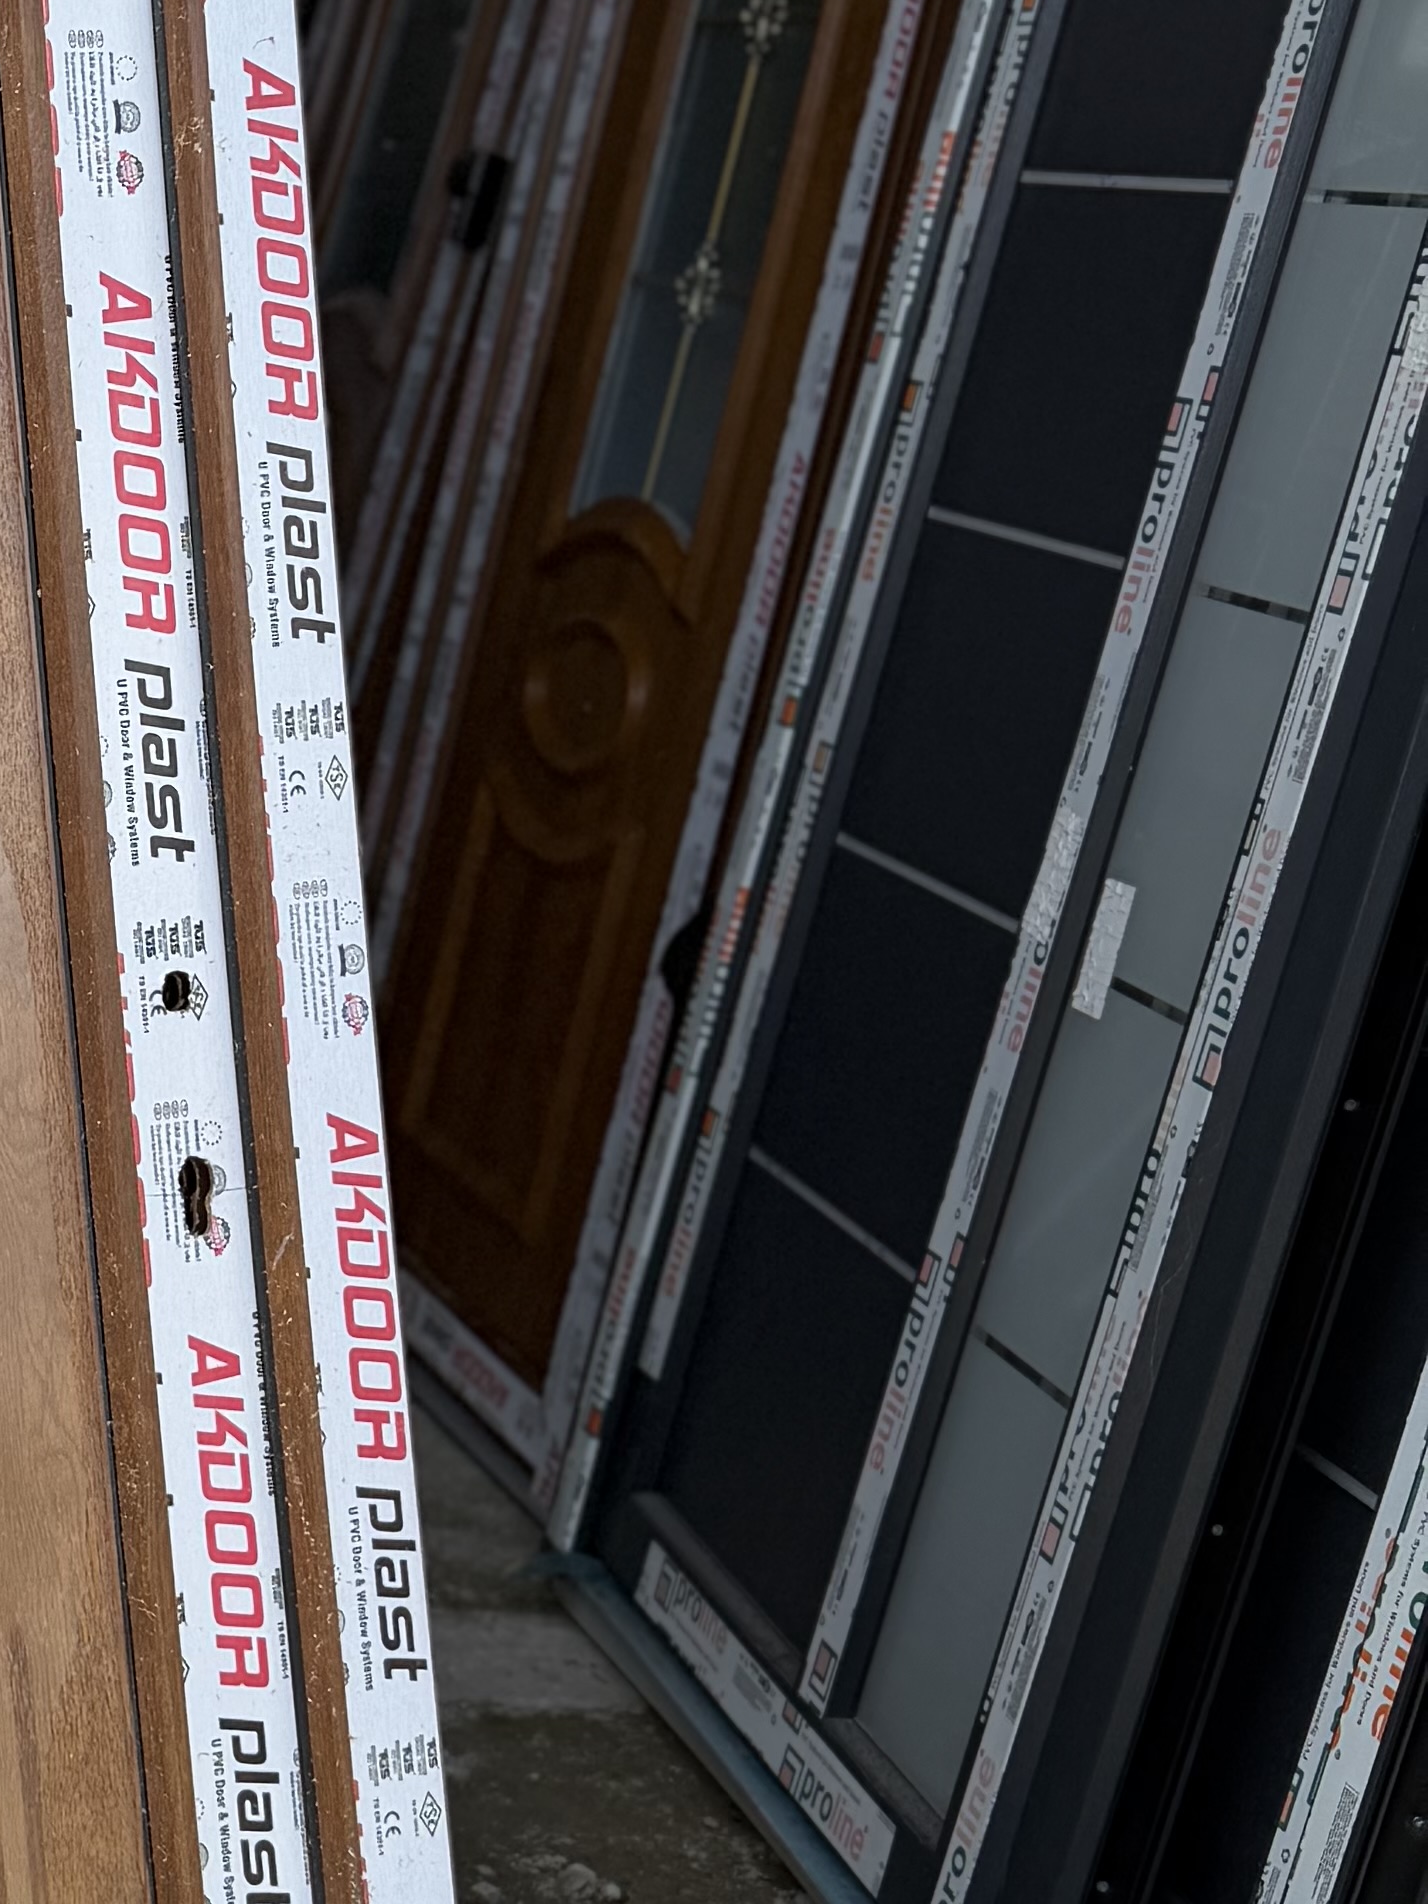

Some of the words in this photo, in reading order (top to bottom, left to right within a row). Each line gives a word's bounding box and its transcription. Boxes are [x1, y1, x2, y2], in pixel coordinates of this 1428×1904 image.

[244, 58, 318, 421] AKDOOR
[98, 272, 176, 635] AKDOOR
[266, 441, 335, 644] plast
[1115, 464, 1175, 634] proline
[124, 658, 195, 862] plast
[1215, 831, 1282, 1019] proline
[326, 1113, 406, 1461] AKDOOR
[870, 1306, 925, 1472] proline
[187, 1336, 269, 1689] AKDOOR
[356, 1486, 428, 1682] plast
